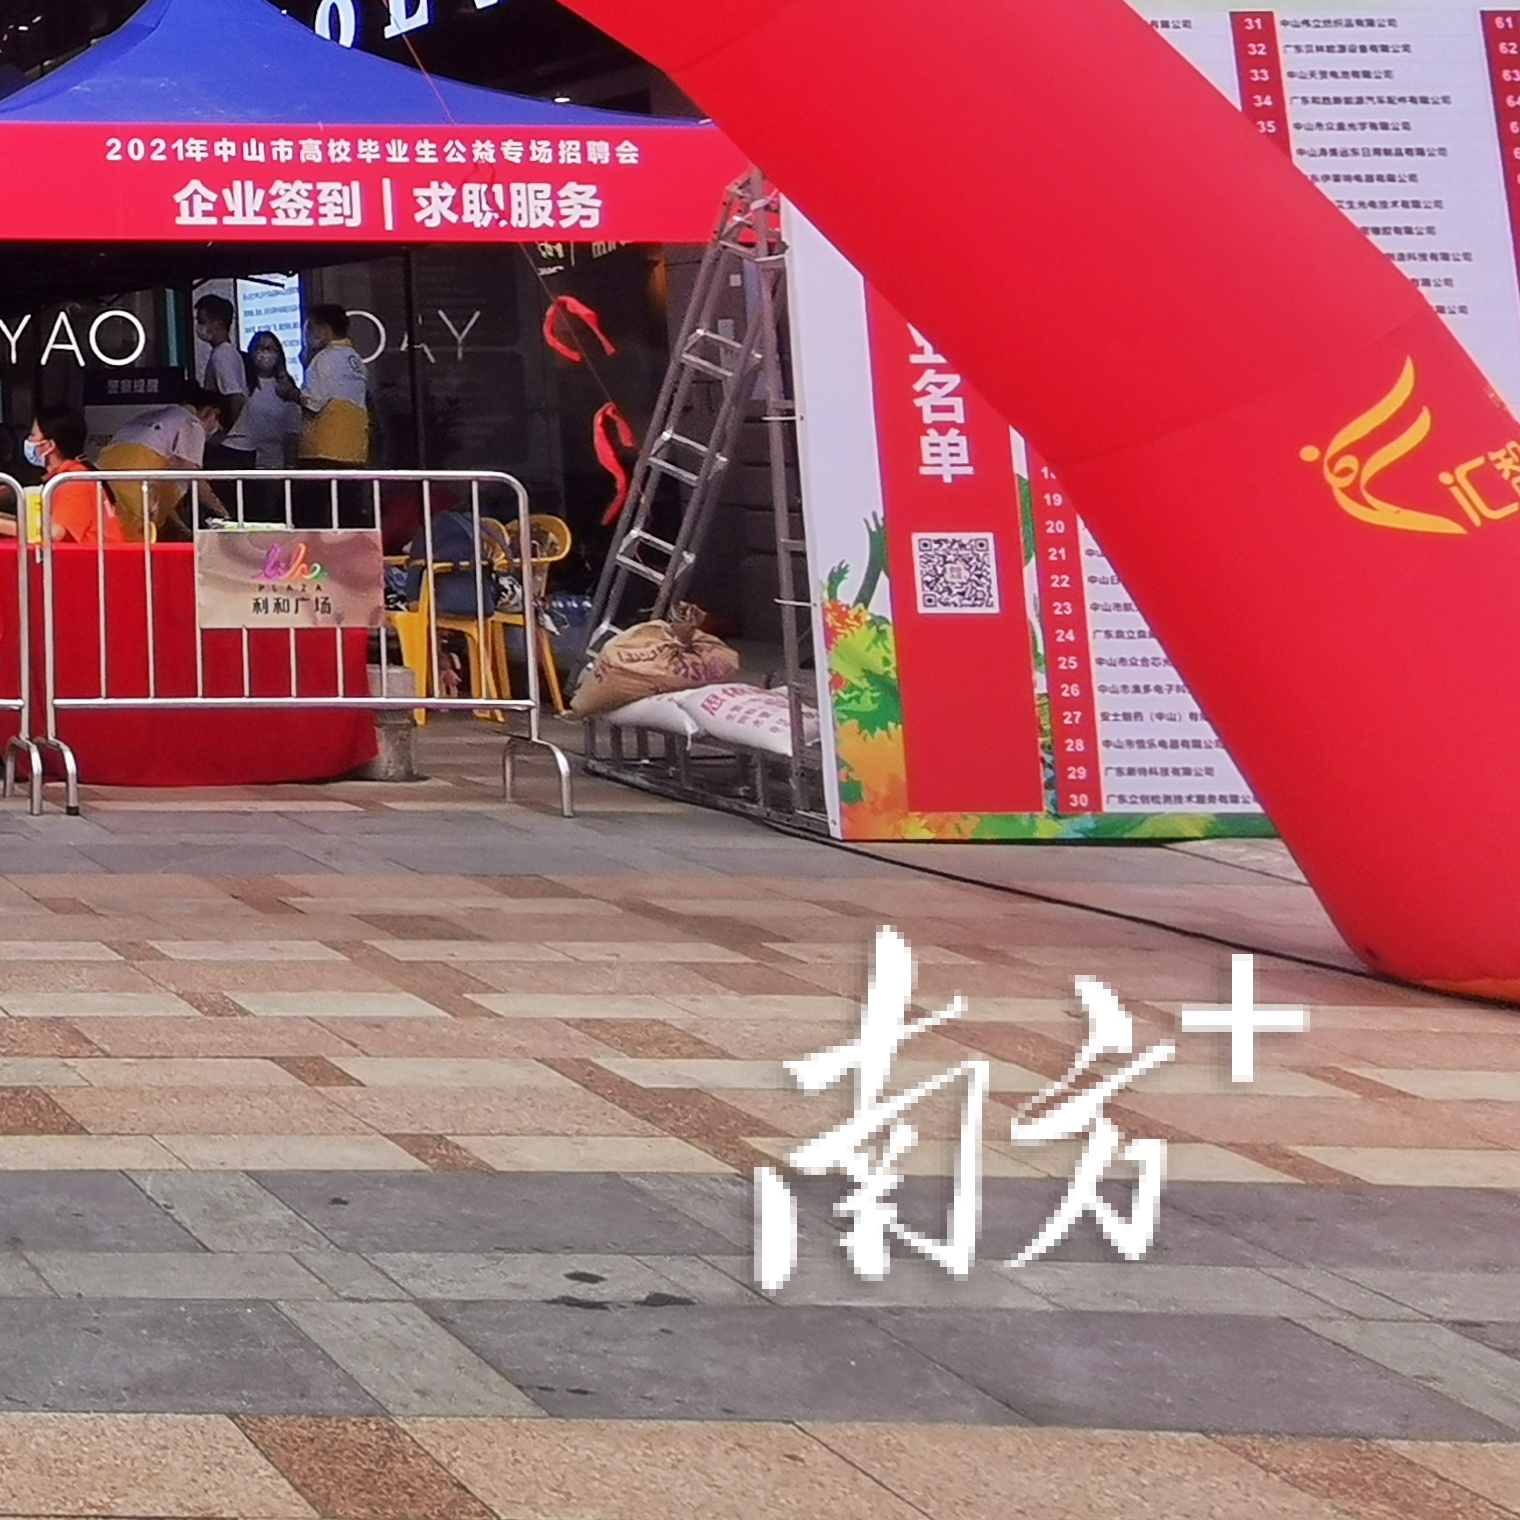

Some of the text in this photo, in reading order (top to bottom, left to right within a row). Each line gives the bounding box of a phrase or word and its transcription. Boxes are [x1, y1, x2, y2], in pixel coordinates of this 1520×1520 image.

[1244, 18, 1263, 30] 31
[1495, 17, 1514, 29] 61
[1248, 44, 1267, 56] 32
[1499, 42, 1519, 55] 62
[1250, 69, 1270, 82] 33
[1253, 95, 1273, 107] 34
[105, 137, 640, 165] 2021年中山市高校毕业生公益专场招聘会
[172, 178, 603, 229] 企业签到 求职服务
[1044, 493, 1063, 507] 19
[1045, 520, 1065, 534] 20
[1048, 547, 1066, 561] 21
[258, 583, 324, 592] PLAZA
[1050, 574, 1071, 588] 22
[251, 596, 333, 615] 利和广场
[1053, 602, 1073, 615] 23
[1055, 629, 1076, 642] 24
[1058, 656, 1078, 670] 25
[1060, 684, 1081, 697] 26
[1062, 711, 1082, 725] 27
[1065, 738, 1085, 752] 28
[1067, 766, 1087, 779] 29
[1069, 793, 1089, 807] 30
